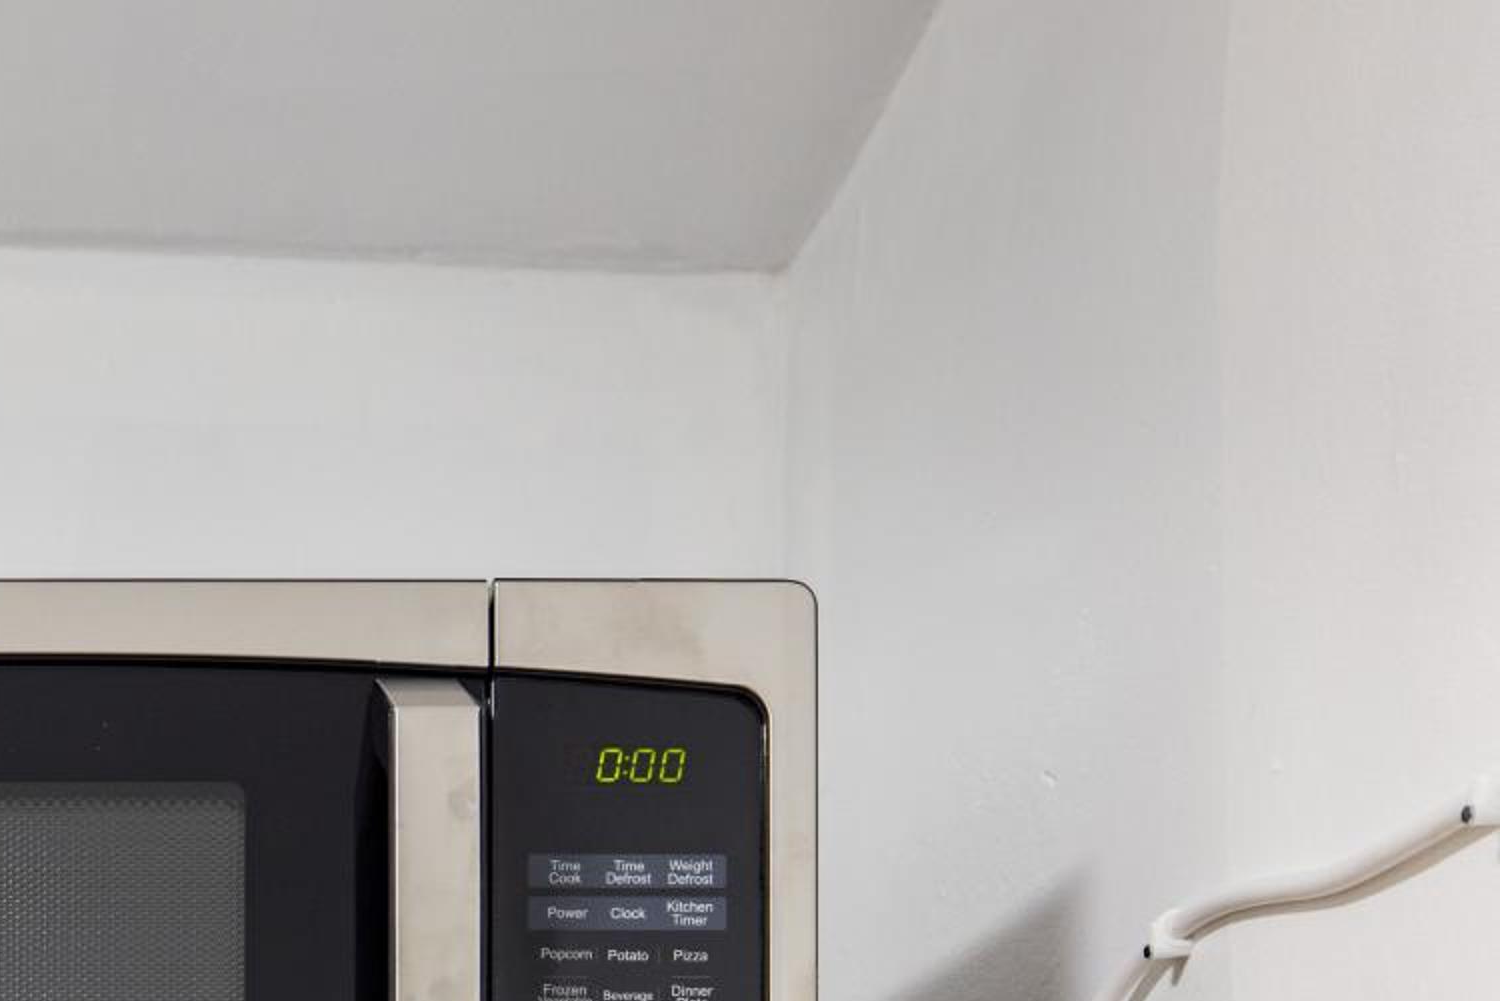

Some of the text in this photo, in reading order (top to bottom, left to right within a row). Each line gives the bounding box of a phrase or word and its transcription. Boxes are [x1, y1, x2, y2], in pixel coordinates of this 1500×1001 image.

[596, 747, 687, 783] 0:00
[551, 859, 581, 872] Time
[613, 859, 645, 872] Time
[668, 859, 714, 875] Weight
[548, 872, 581, 885] Cook
[605, 872, 651, 885] Defrost
[667, 872, 713, 885] Defrost
[547, 906, 589, 919] Power
[610, 906, 646, 920] Clock
[666, 900, 714, 913] Kitchen
[671, 914, 708, 926] Timer
[540, 947, 593, 963] Popcorn
[607, 949, 649, 962] Potato
[673, 949, 708, 962] Pizza
[543, 983, 587, 996] Frozen
[671, 984, 714, 997] Dinner
